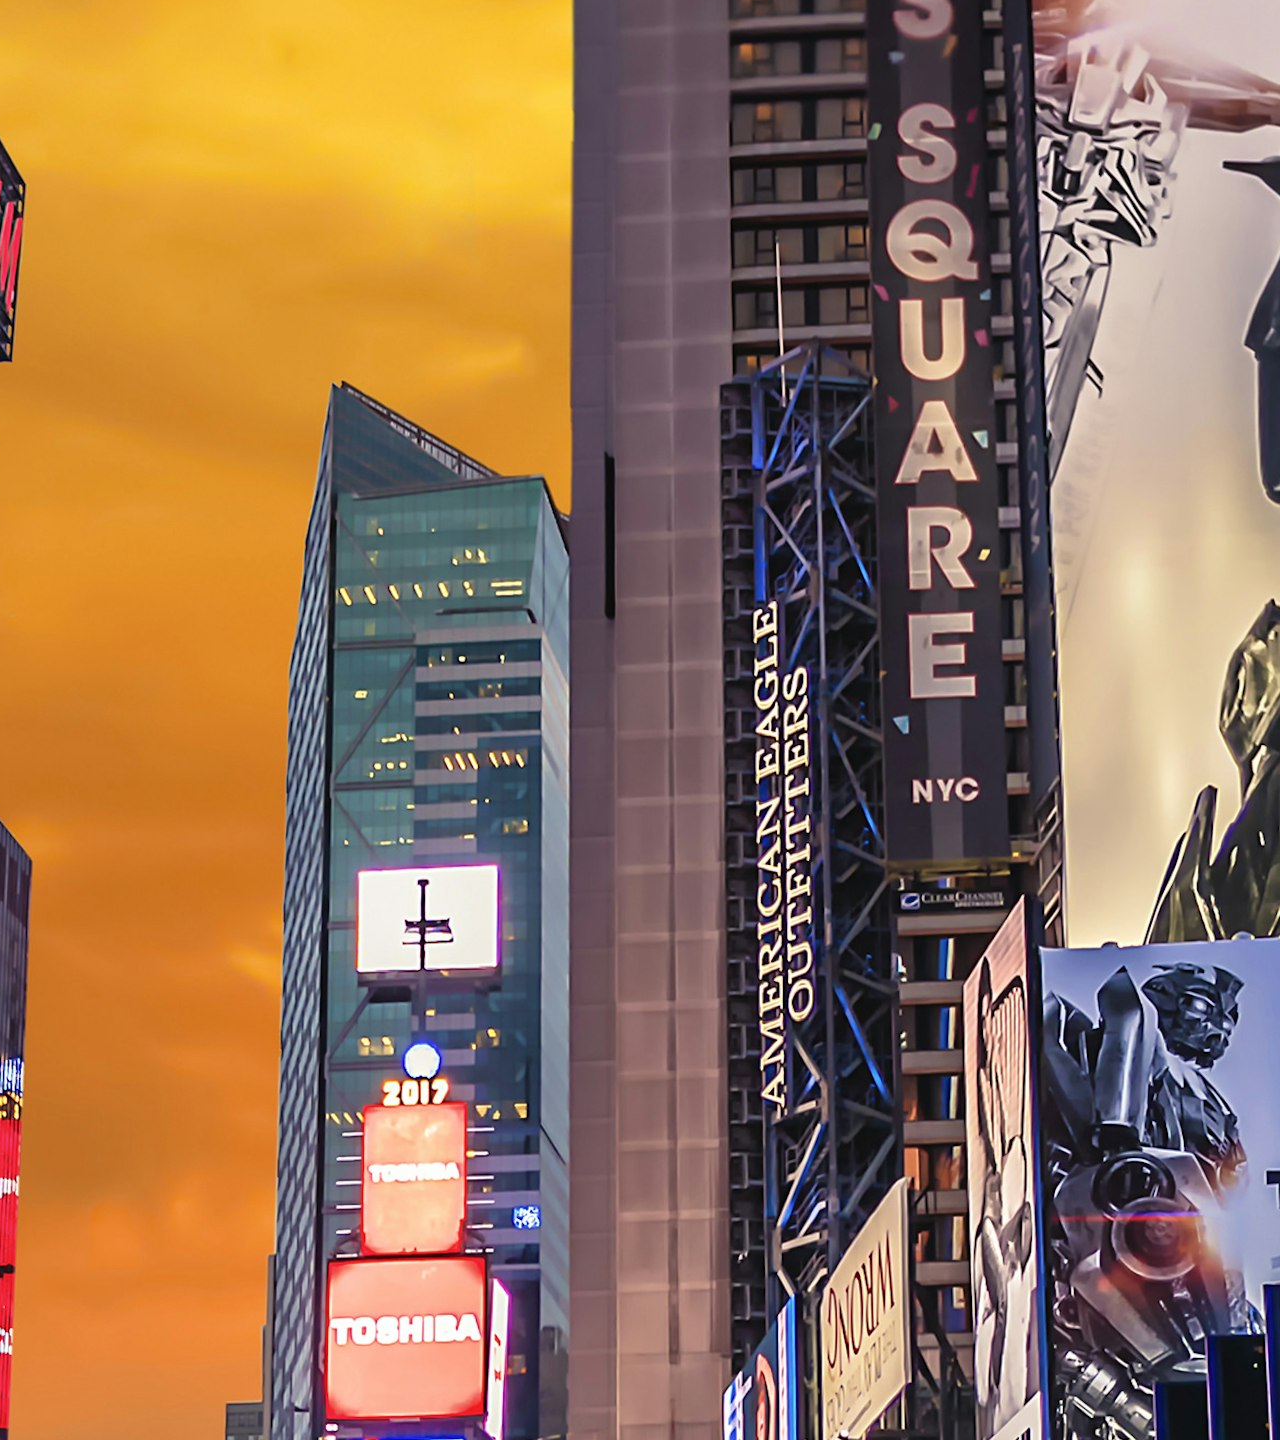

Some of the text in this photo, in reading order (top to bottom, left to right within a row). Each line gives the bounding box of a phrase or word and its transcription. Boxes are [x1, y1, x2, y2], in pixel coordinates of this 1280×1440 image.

[887, 101, 983, 700] SQUARE
[912, 777, 979, 804] NYC
[752, 600, 786, 1109] AMERICAN EAGLE
[782, 665, 815, 1022] OUTFITTERS
[382, 1080, 449, 1106] 2017
[368, 1161, 460, 1185] TOSHIBA
[330, 1313, 481, 1347] TOSHIBA
